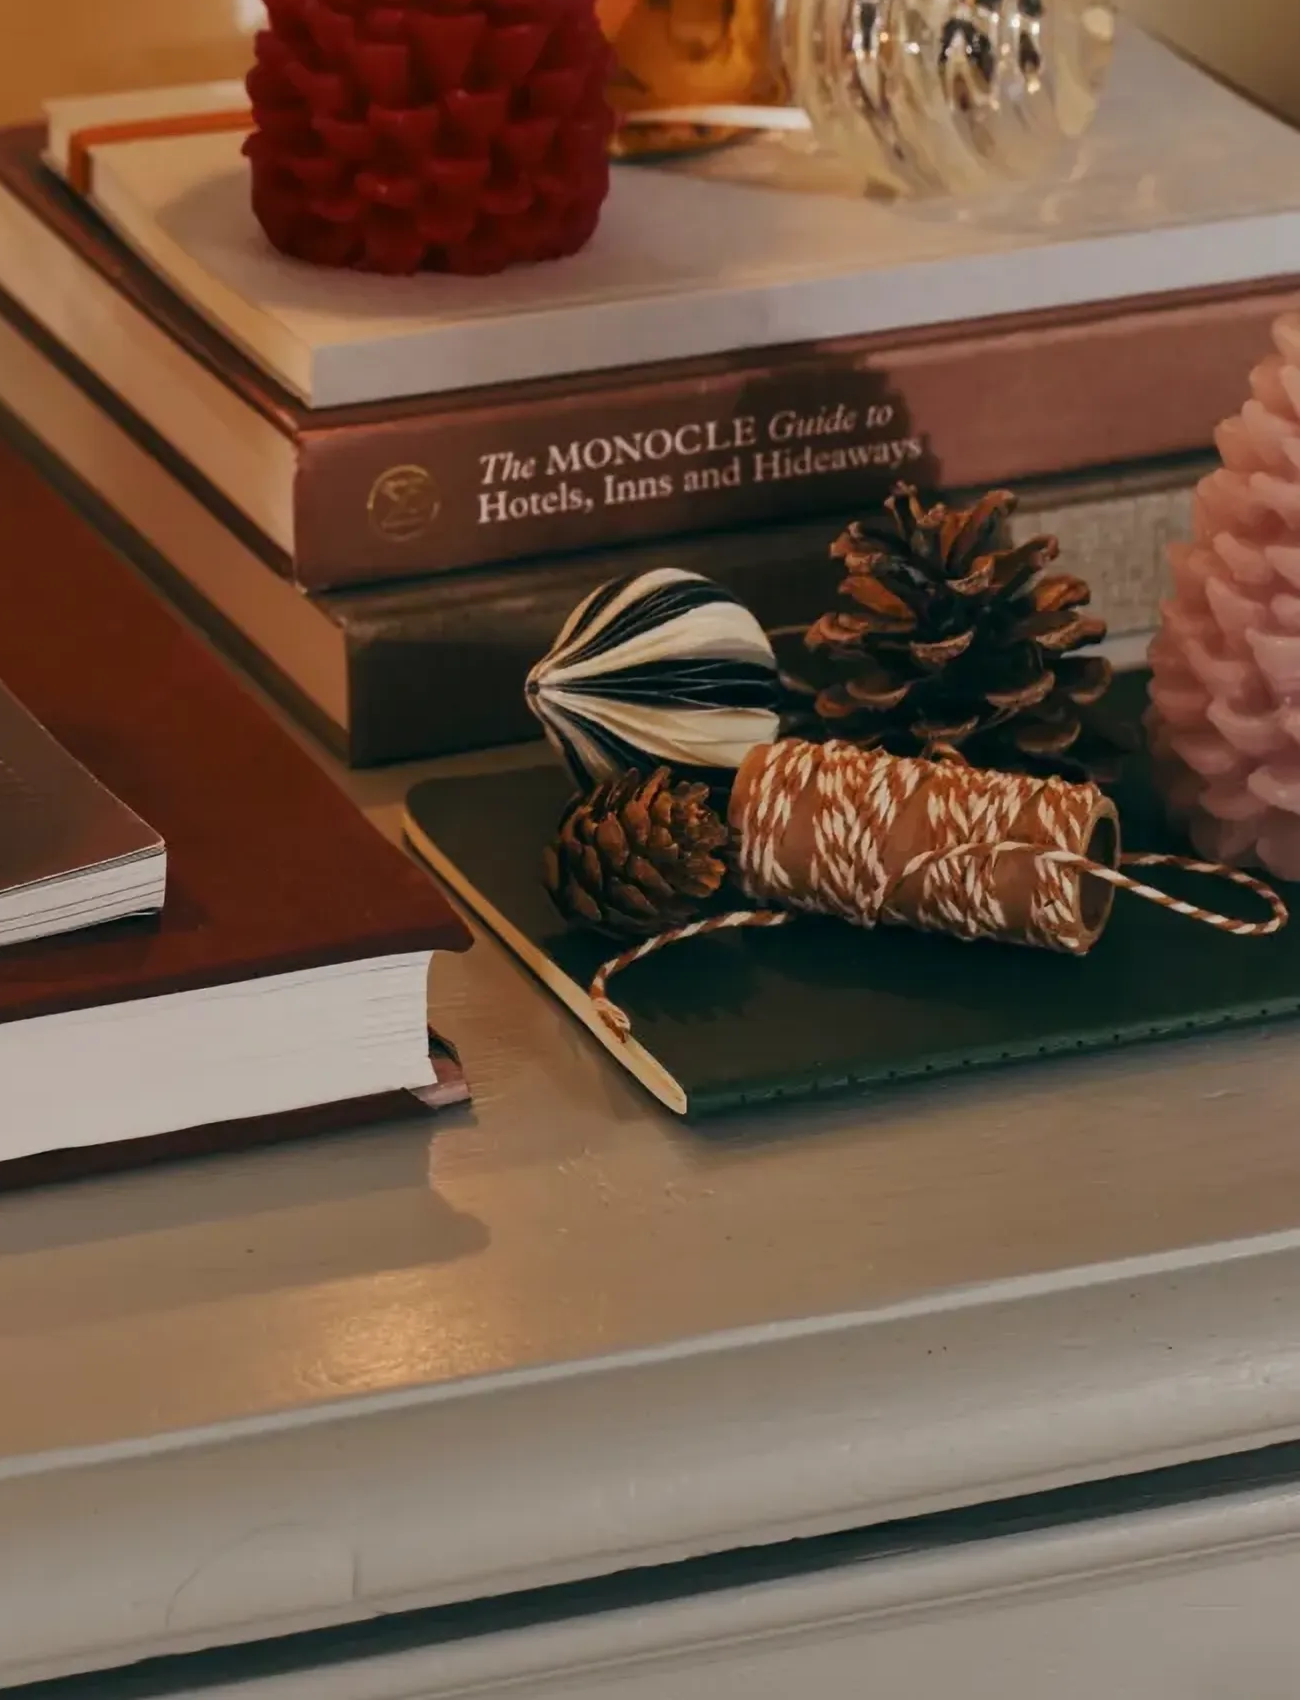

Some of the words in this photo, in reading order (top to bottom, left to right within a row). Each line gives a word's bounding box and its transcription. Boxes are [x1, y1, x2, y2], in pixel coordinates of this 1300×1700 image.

[477, 482, 595, 524] Hotels,
[603, 474, 674, 505] Inns
[683, 456, 741, 493] and
[753, 436, 923, 482] Hideaways
[479, 451, 536, 485] The
[544, 415, 757, 475] MONOCLE
[767, 404, 858, 442] Guide
[865, 404, 895, 429] to
